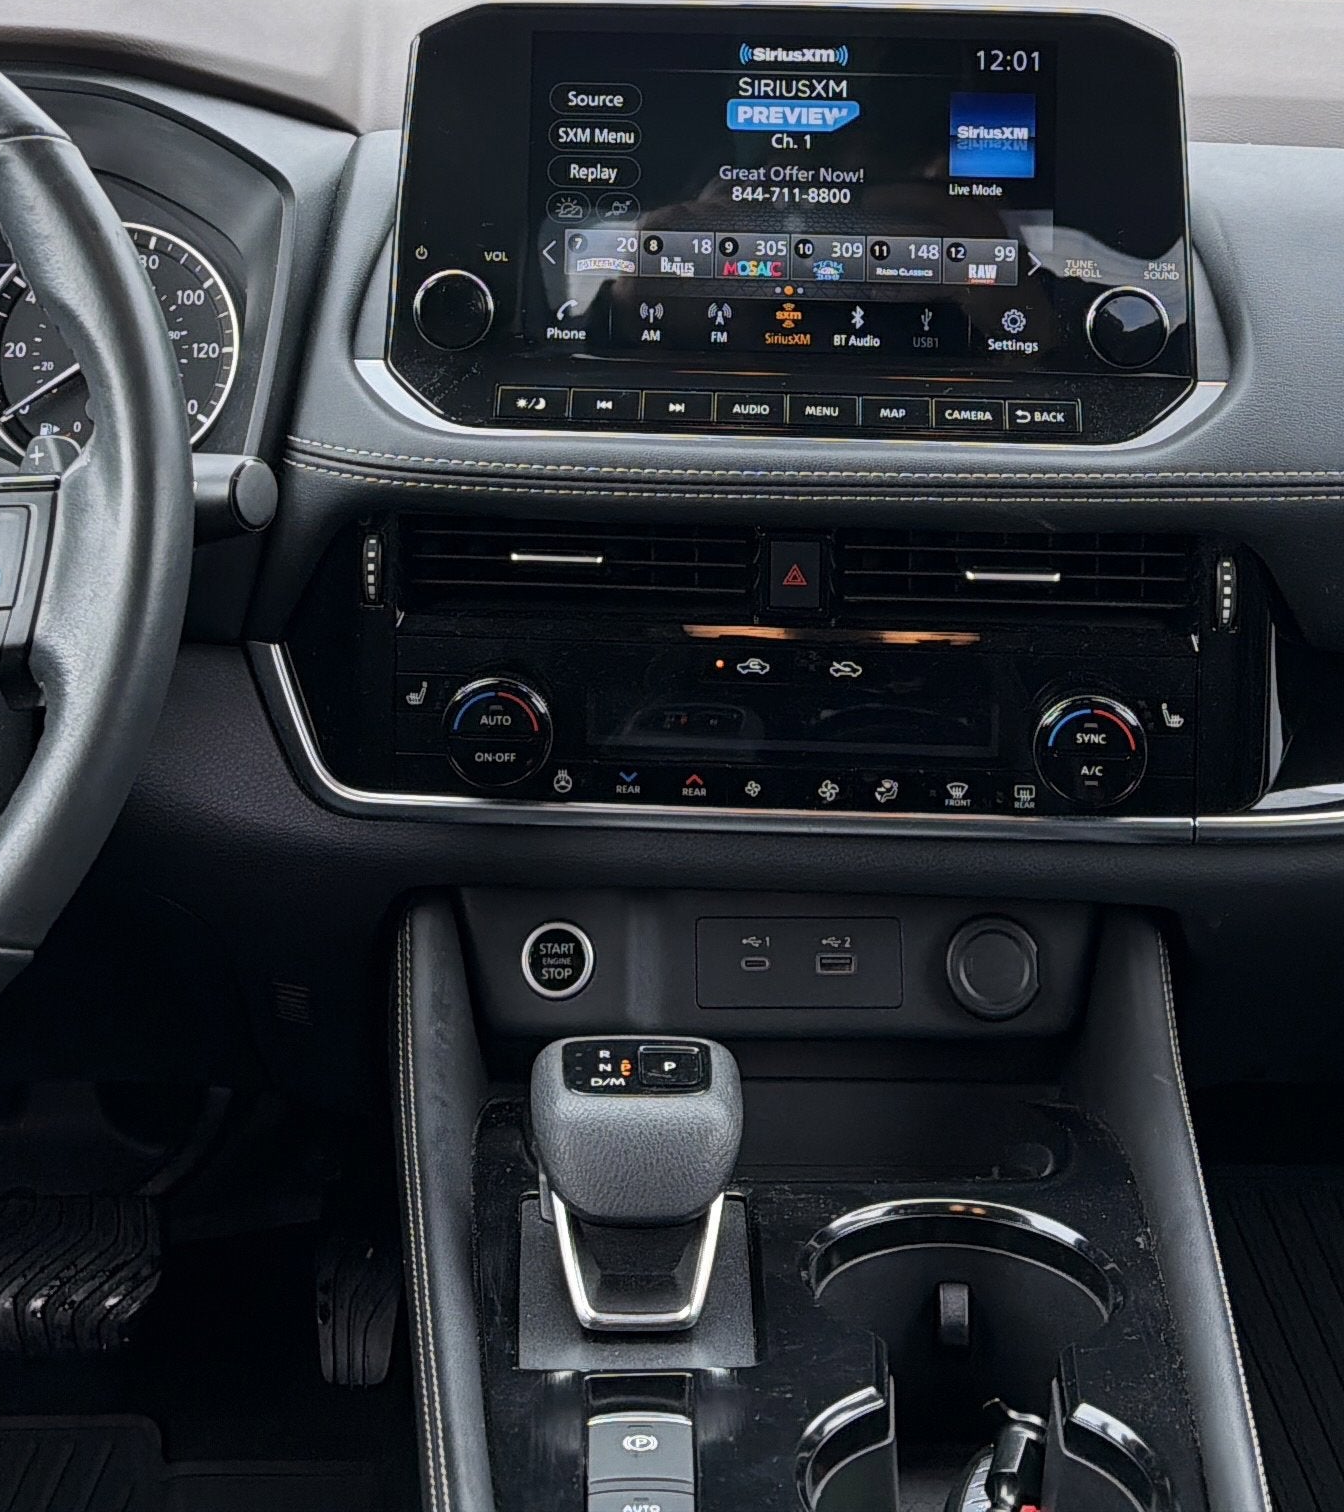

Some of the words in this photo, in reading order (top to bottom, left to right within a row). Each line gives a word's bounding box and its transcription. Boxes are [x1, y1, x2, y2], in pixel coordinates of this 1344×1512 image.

[976, 50, 1041, 72] 12:01
[738, 77, 848, 98] SIRIUSXM
[568, 91, 624, 108] Source
[737, 106, 848, 125] PREVIEW
[558, 127, 591, 144] SXM
[595, 128, 635, 145] Menu
[957, 126, 1029, 139] SiriusXM
[771, 134, 799, 149] Ch.
[803, 135, 812, 149] 1
[570, 164, 617, 183] Replay
[719, 166, 766, 182] Great
[771, 166, 815, 182] Offer
[819, 167, 865, 184] Now!
[732, 187, 851, 205] 844-711-8800
[949, 184, 970, 196] Live
[972, 184, 1003, 196] Mode
[616, 237, 638, 252] 20
[649, 240, 658, 251] 8
[692, 239, 712, 254] 18
[724, 241, 733, 253] 9
[755, 240, 787, 256] 305
[798, 243, 813, 255] 10
[831, 241, 863, 258] 309
[873, 244, 888, 257] 11
[484, 251, 509, 261] VOL
[909, 244, 939, 260] 148
[949, 246, 966, 258] 12
[995, 246, 1016, 262] 99
[723, 261, 782, 276] MOSAIC
[968, 264, 998, 279] RAW
[1148, 262, 1175, 271] PUSH
[1064, 268, 1102, 278] SCROLL
[1143, 271, 1179, 280] SOUND
[176, 290, 205, 305] 100
[775, 310, 802, 320] sxm
[546, 327, 587, 340] Phone
[641, 330, 661, 341] AM
[711, 331, 728, 343] FM
[765, 333, 811, 345] SiriusXM
[834, 335, 847, 346] BT
[849, 335, 881, 347] Audio
[913, 337, 939, 348] USB1
[988, 339, 1039, 354] Settings
[4, 343, 27, 358] 20
[192, 343, 219, 358] 120
[41, 362, 54, 371] 20
[732, 403, 770, 416] AUDIO
[805, 405, 839, 417] MENU
[880, 408, 906, 419] MAP
[945, 409, 993, 422] CAMERA
[1035, 410, 1065, 423] BACK
[479, 715, 512, 726] AUTO
[1076, 733, 1107, 744] SYNC
[1080, 766, 1103, 776] A/C
[616, 785, 640, 794] REAR
[682, 787, 707, 797] REAR
[945, 799, 971, 807] FRONT
[1014, 801, 1035, 809] REAR
[844, 936, 851, 947] 2
[539, 942, 575, 955] START
[542, 957, 572, 965] ENGINE
[541, 967, 573, 979] STOP
[599, 1050, 611, 1059] R
[598, 1063, 612, 1072] N
[664, 1061, 676, 1072] P
[591, 1077, 626, 1087] D/M
